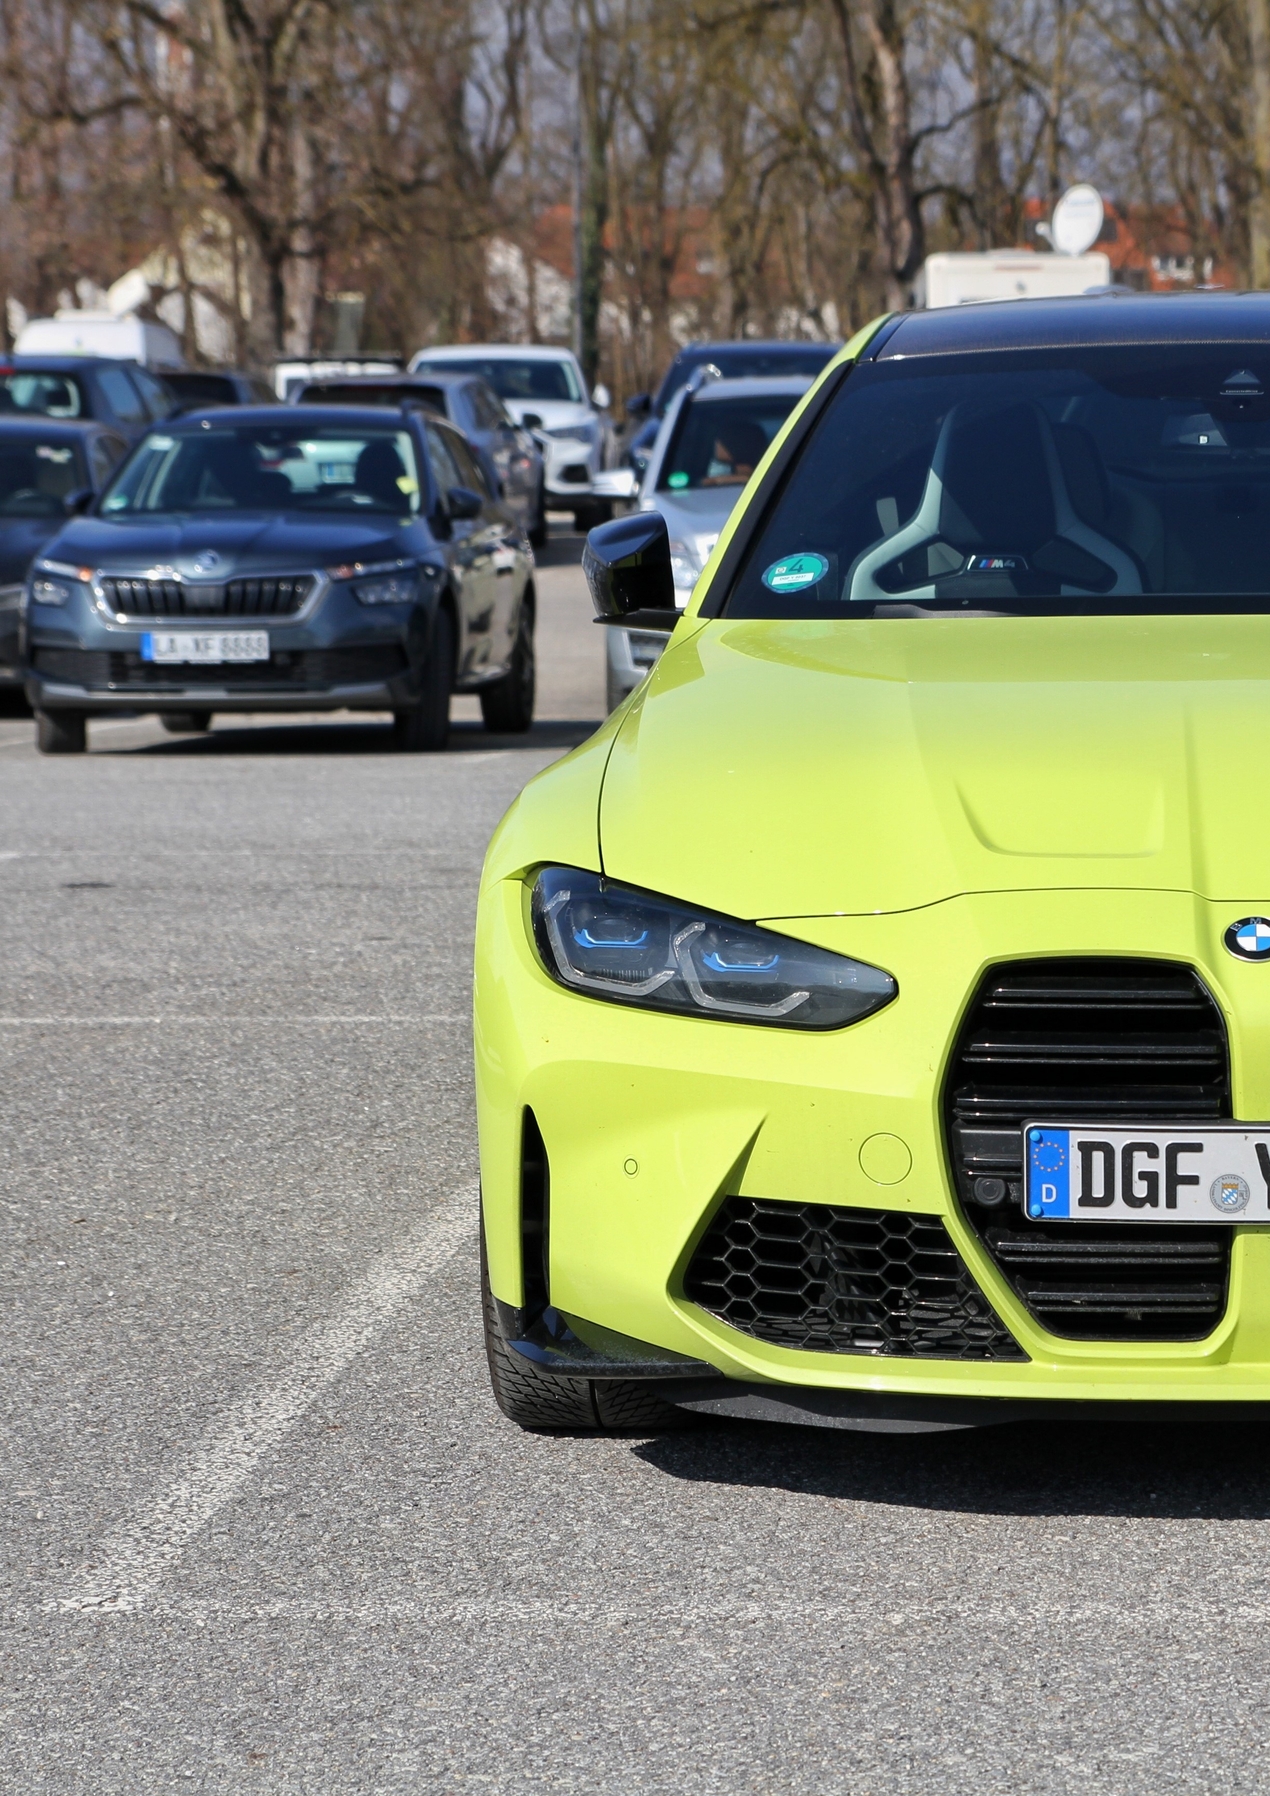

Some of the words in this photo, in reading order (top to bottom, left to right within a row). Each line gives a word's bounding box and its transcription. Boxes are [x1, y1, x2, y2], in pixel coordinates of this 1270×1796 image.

[788, 558, 804, 573] 4
[990, 559, 1016, 569] M4
[1077, 1140, 1204, 1209] DGF
[1041, 1184, 1057, 1203] D
